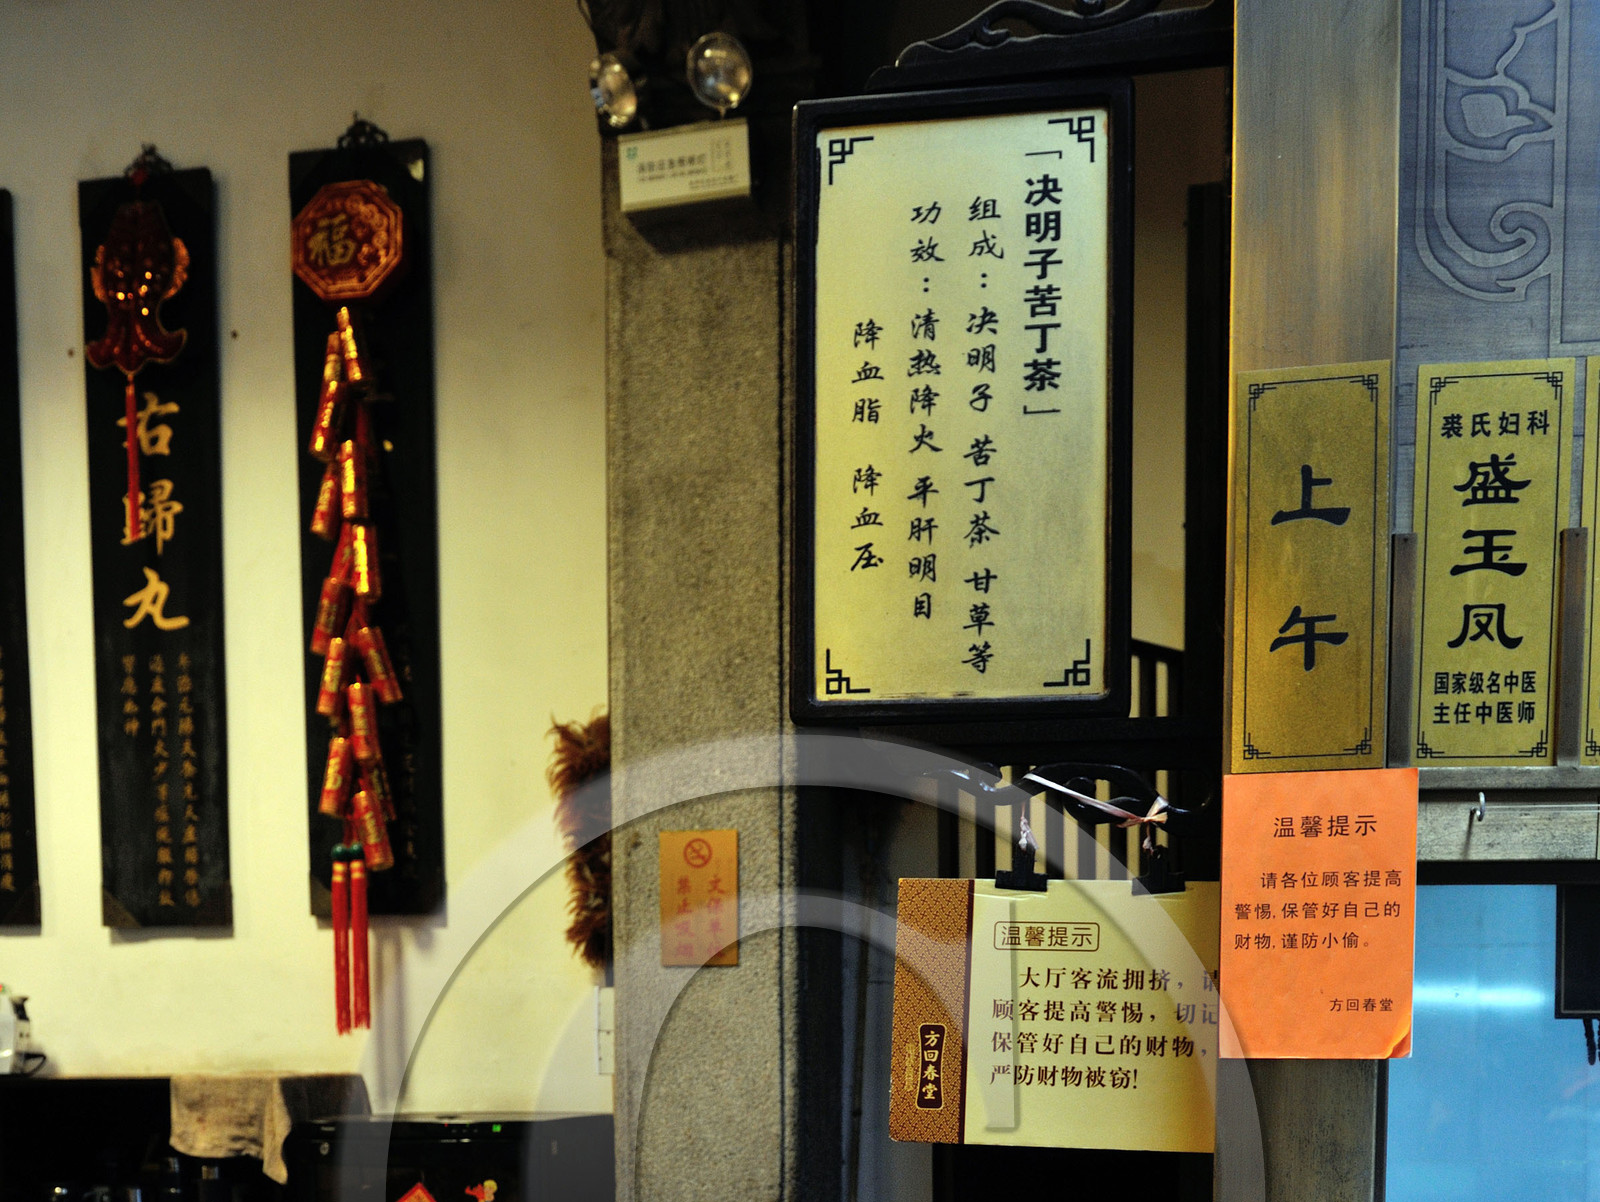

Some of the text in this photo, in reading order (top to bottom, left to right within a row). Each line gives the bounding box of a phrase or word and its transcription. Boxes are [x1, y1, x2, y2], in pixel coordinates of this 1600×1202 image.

[307, 212, 357, 266] 福
[1024, 149, 1063, 415] 「决明子苦丁茶」
[851, 321, 884, 425] 降血脂
[907, 201, 944, 620] 功效：清热降火 平肝明目
[961, 195, 1004, 675] 组成：决明子 苦丁茶 甘草等
[1440, 410, 1551, 439] 裘氏妇科
[1448, 453, 1532, 650] 盛玉凤
[1269, 464, 1351, 671] 上午
[1434, 671, 1537, 696] 国家级名中医
[1433, 701, 1536, 725] 主任中医师
[1273, 815, 1378, 839] 温馨提示
[1260, 869, 1402, 889] 请各位顾客提高
[1234, 901, 1401, 921] 警惕，保管好自己的
[1001, 925, 1092, 948] 温馨提示
[1234, 931, 1370, 950] 财物，谨防小偷。
[1329, 998, 1394, 1012] 方回春堂
[990, 1032, 1207, 1057] 保管好自己的财物，
[922, 1030, 940, 1099] 方回春堂
